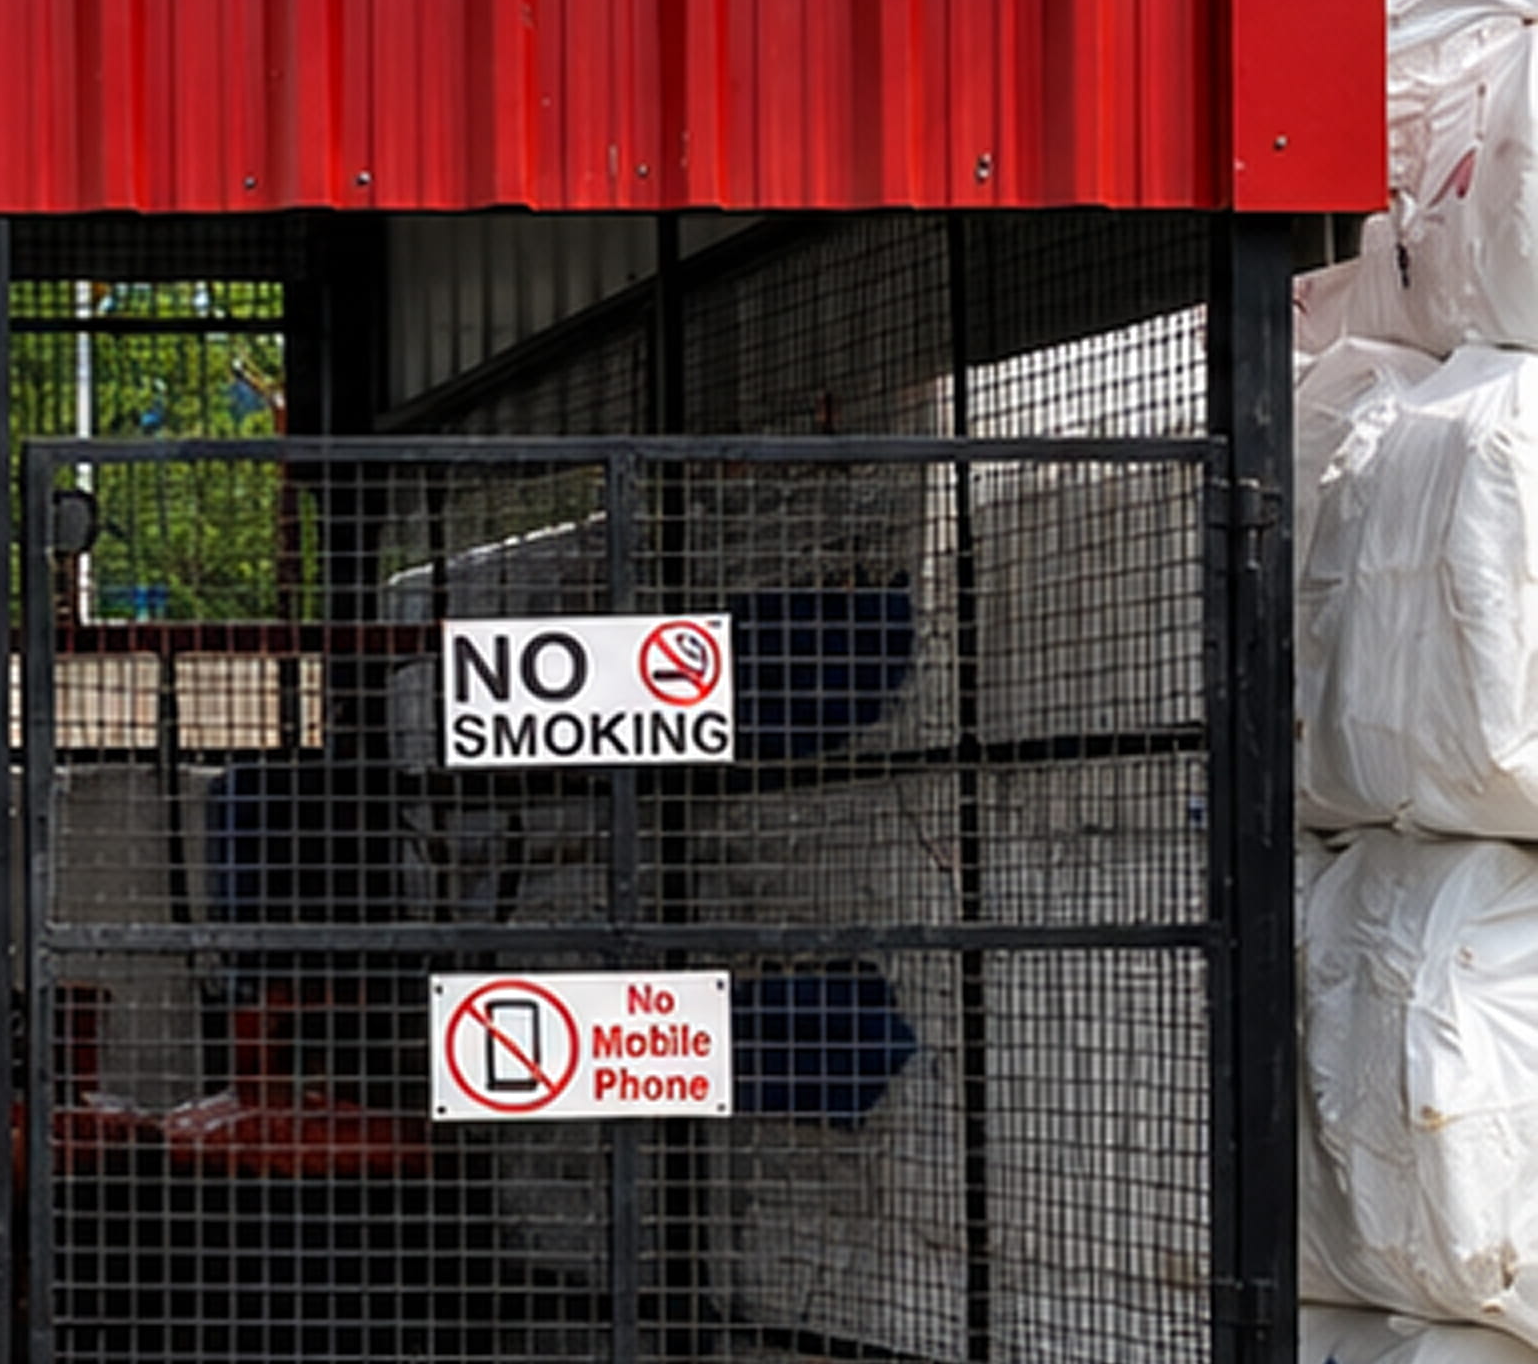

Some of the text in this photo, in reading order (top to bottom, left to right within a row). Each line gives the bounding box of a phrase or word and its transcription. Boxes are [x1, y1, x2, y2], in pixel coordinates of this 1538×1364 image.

[453, 633, 588, 703] NO
[453, 710, 729, 759] SMOKING
[627, 984, 675, 1015] No
[592, 1024, 711, 1059] Mobile
[594, 1067, 709, 1101] Phone
